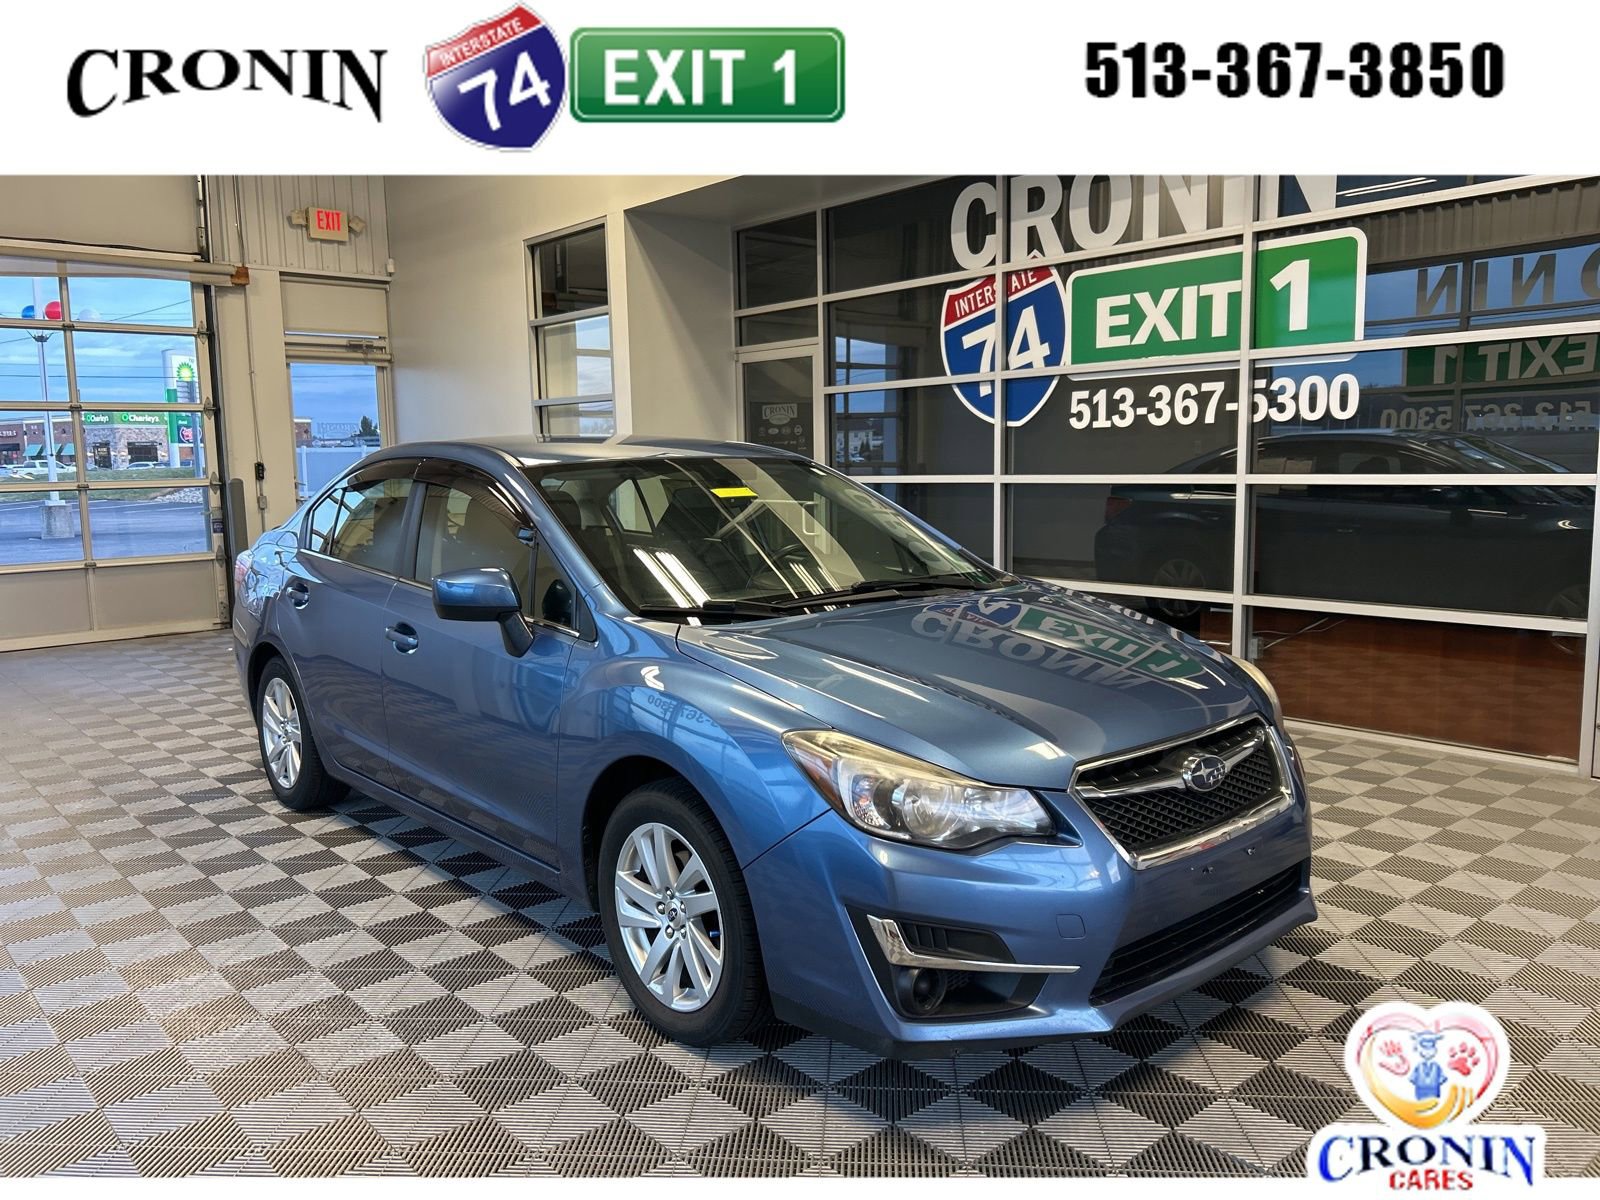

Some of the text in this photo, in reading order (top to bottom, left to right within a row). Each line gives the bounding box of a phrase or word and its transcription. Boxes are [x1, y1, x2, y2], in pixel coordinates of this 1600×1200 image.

[316, 209, 342, 232] EXIT
[954, 269, 1038, 318] INTERATE
[1095, 259, 1311, 349] EXIT 1
[961, 304, 1051, 398] 74
[763, 405, 796, 418] CRONIN
[1068, 373, 1359, 429] 513-367-5300
